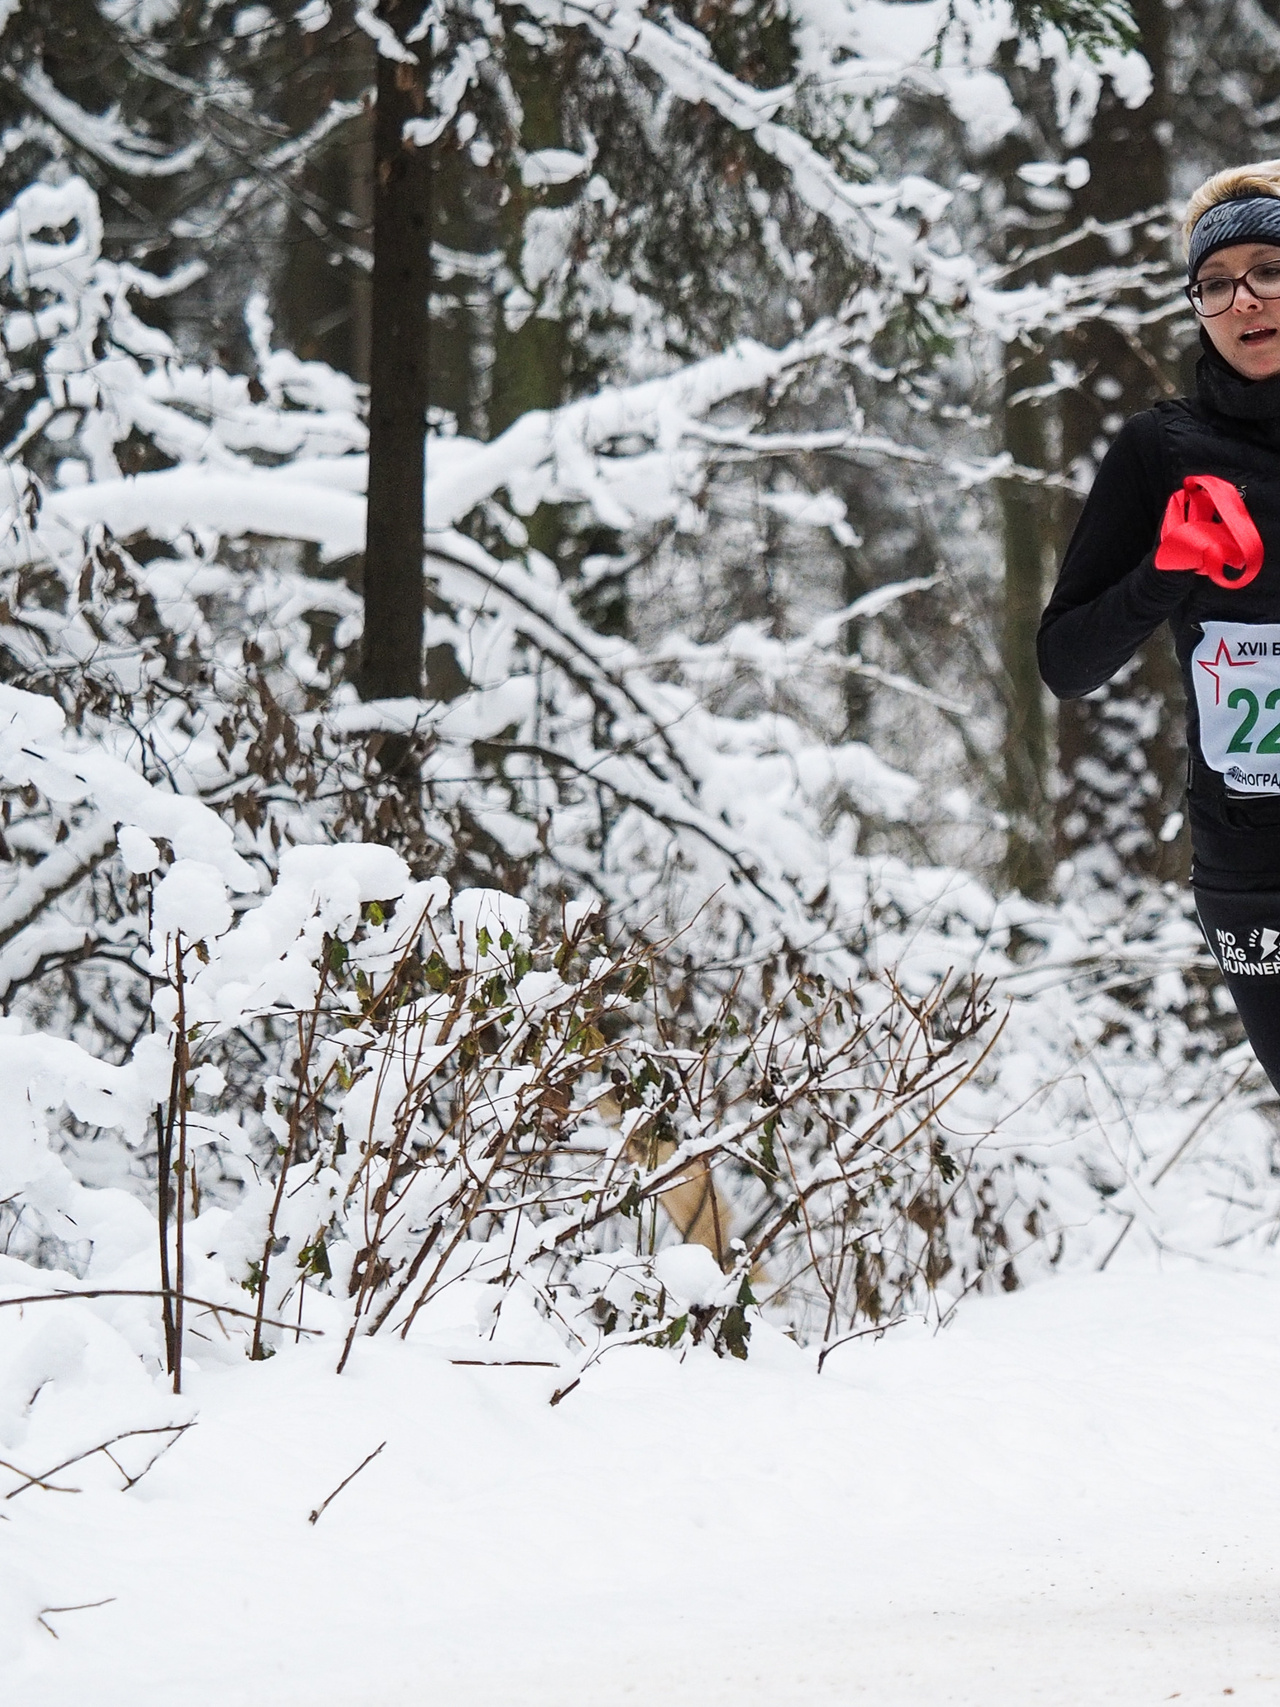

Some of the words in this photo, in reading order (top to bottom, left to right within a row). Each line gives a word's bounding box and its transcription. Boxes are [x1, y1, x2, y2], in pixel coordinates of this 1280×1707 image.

[1237, 642, 1267, 656] XVII
[1216, 928, 1236, 946] NO
[1219, 943, 1247, 961] TAG
